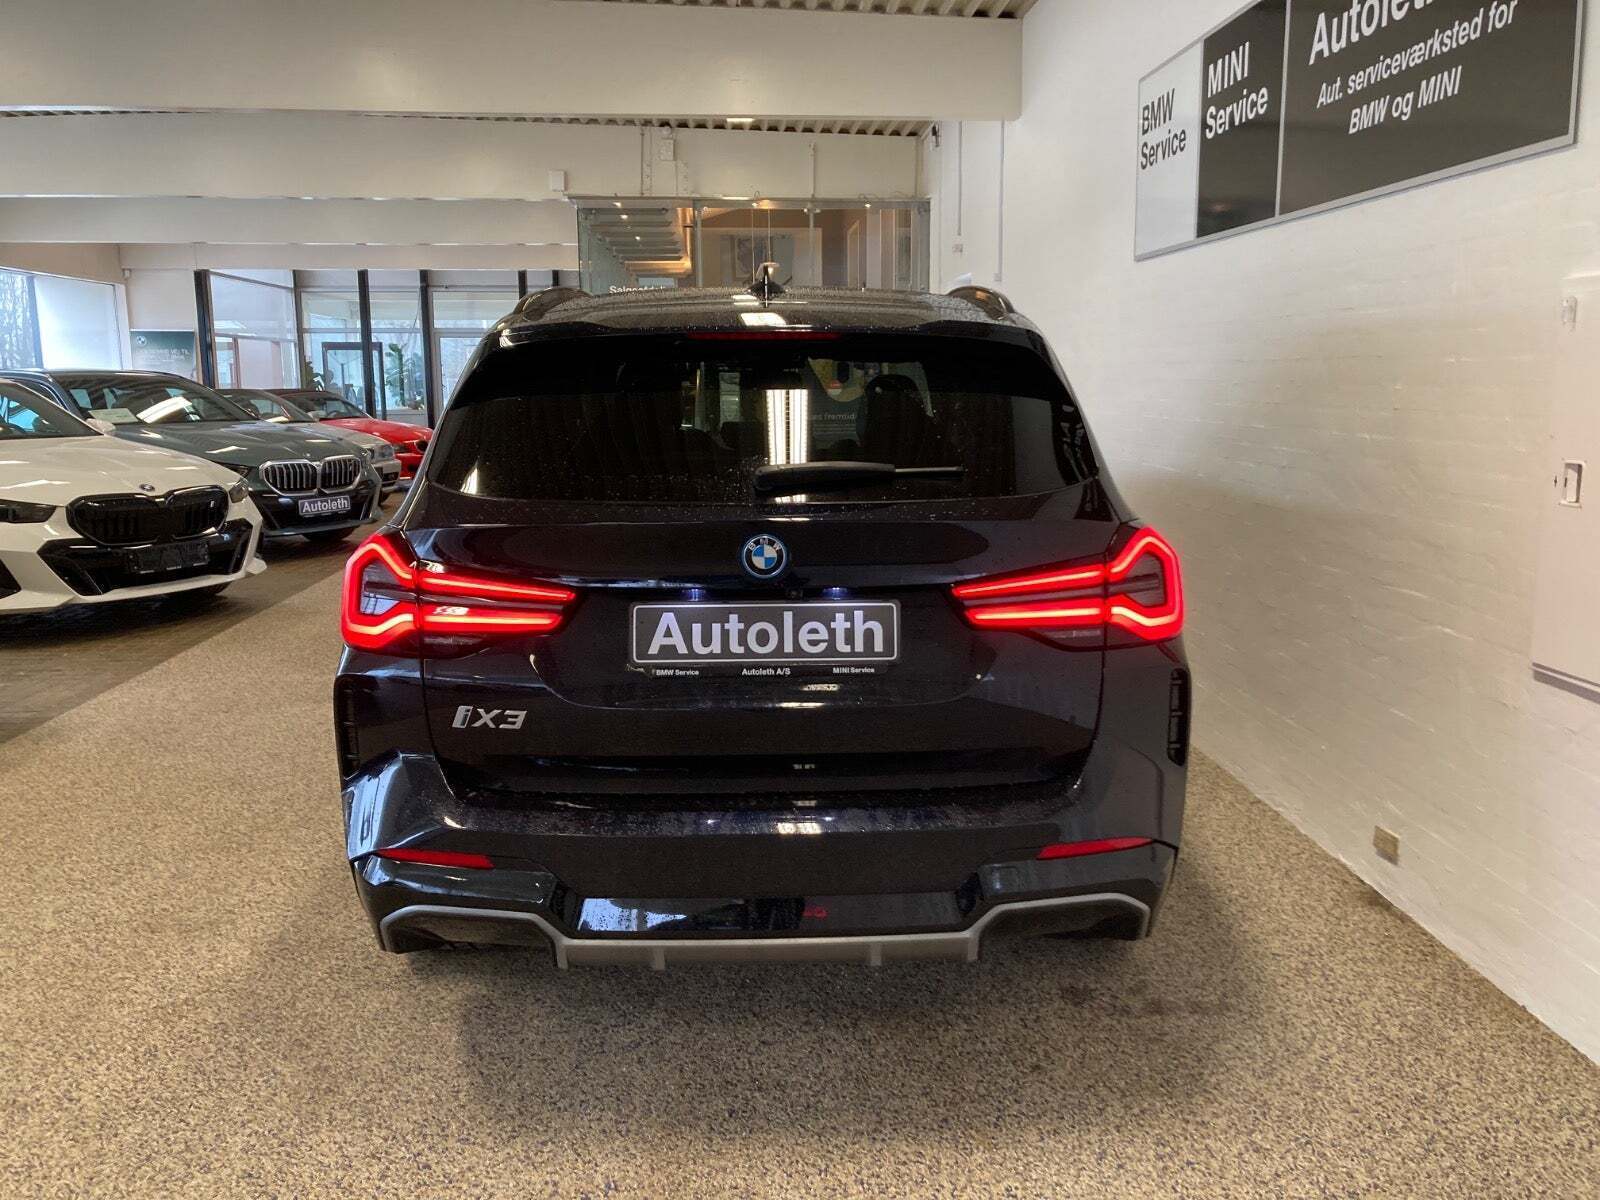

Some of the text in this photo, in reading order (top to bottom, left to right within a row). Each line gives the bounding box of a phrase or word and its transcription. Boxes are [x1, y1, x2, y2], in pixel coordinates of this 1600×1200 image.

[1207, 40, 1249, 99] MINI
[1316, 0, 1518, 108] Aut. serviceværksted for
[1141, 87, 1175, 136] BMW
[1205, 86, 1268, 140] Service
[1349, 65, 1462, 134] BMW og MINI
[1140, 128, 1186, 170] Service
[302, 497, 348, 513] Autoleth
[647, 611, 884, 655] Autoleth
[655, 668, 700, 676] BMW Service
[741, 667, 791, 676] Autoleth A/S
[832, 666, 850, 674] MINI
